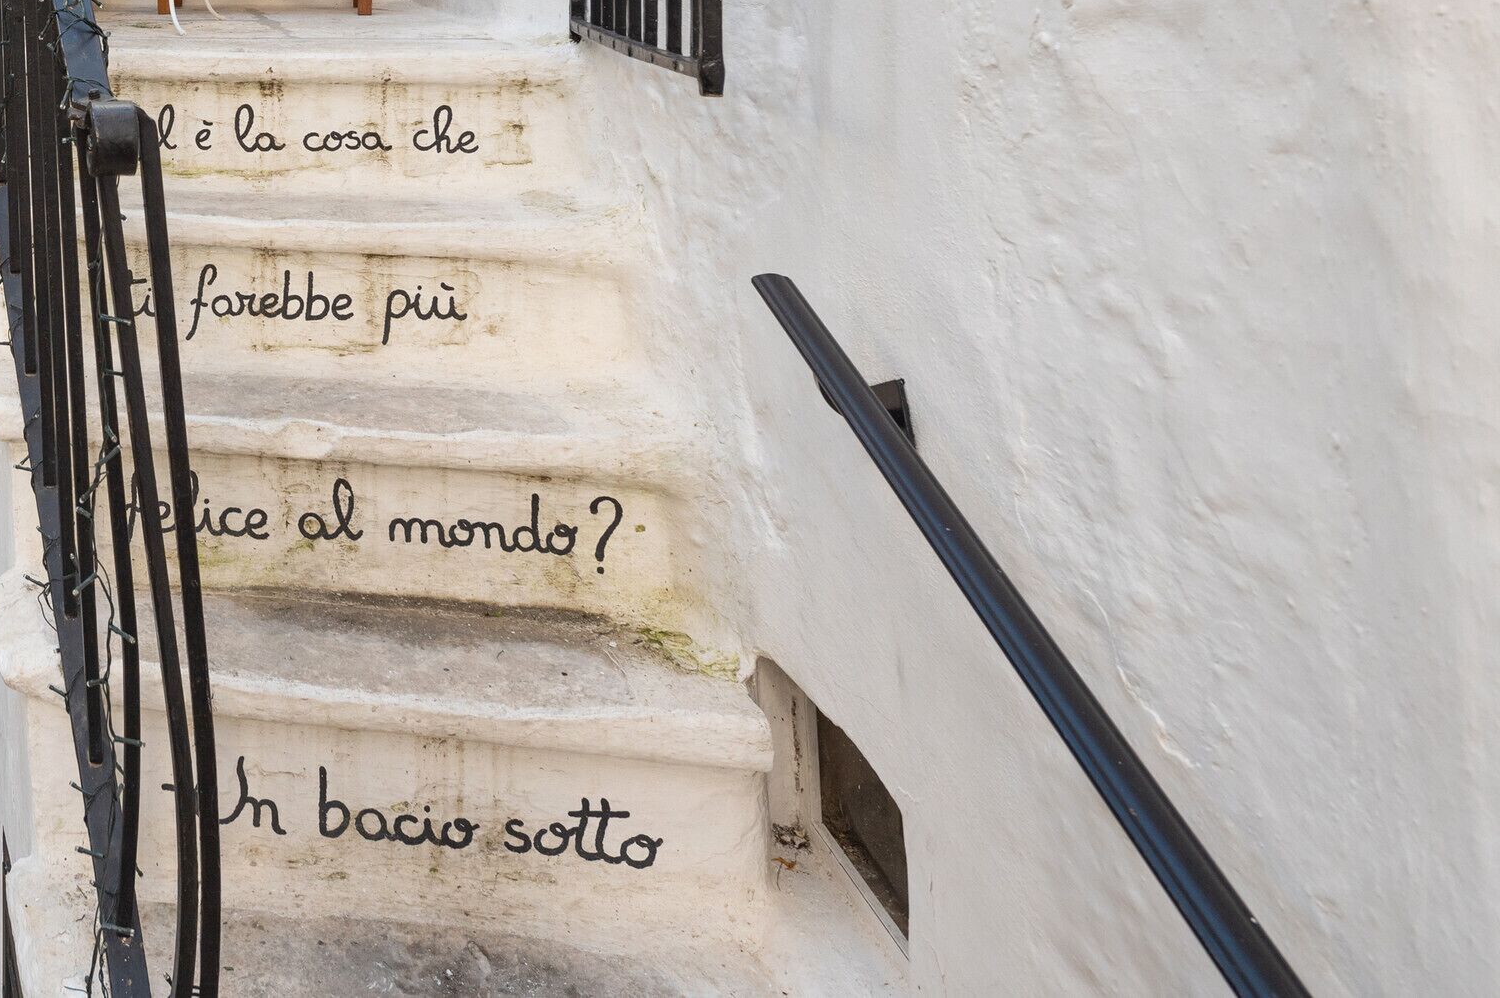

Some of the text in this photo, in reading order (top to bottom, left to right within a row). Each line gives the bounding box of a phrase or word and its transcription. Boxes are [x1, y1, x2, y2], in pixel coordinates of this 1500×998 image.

[195, 119, 214, 151] è
[234, 103, 286, 153] la
[302, 130, 393, 152] cosa
[412, 104, 479, 154] che
[185, 263, 354, 341] farebbe
[381, 282, 468, 346] più
[297, 477, 364, 542] al
[318, 765, 481, 850] bacio
[503, 797, 664, 870] sotto
